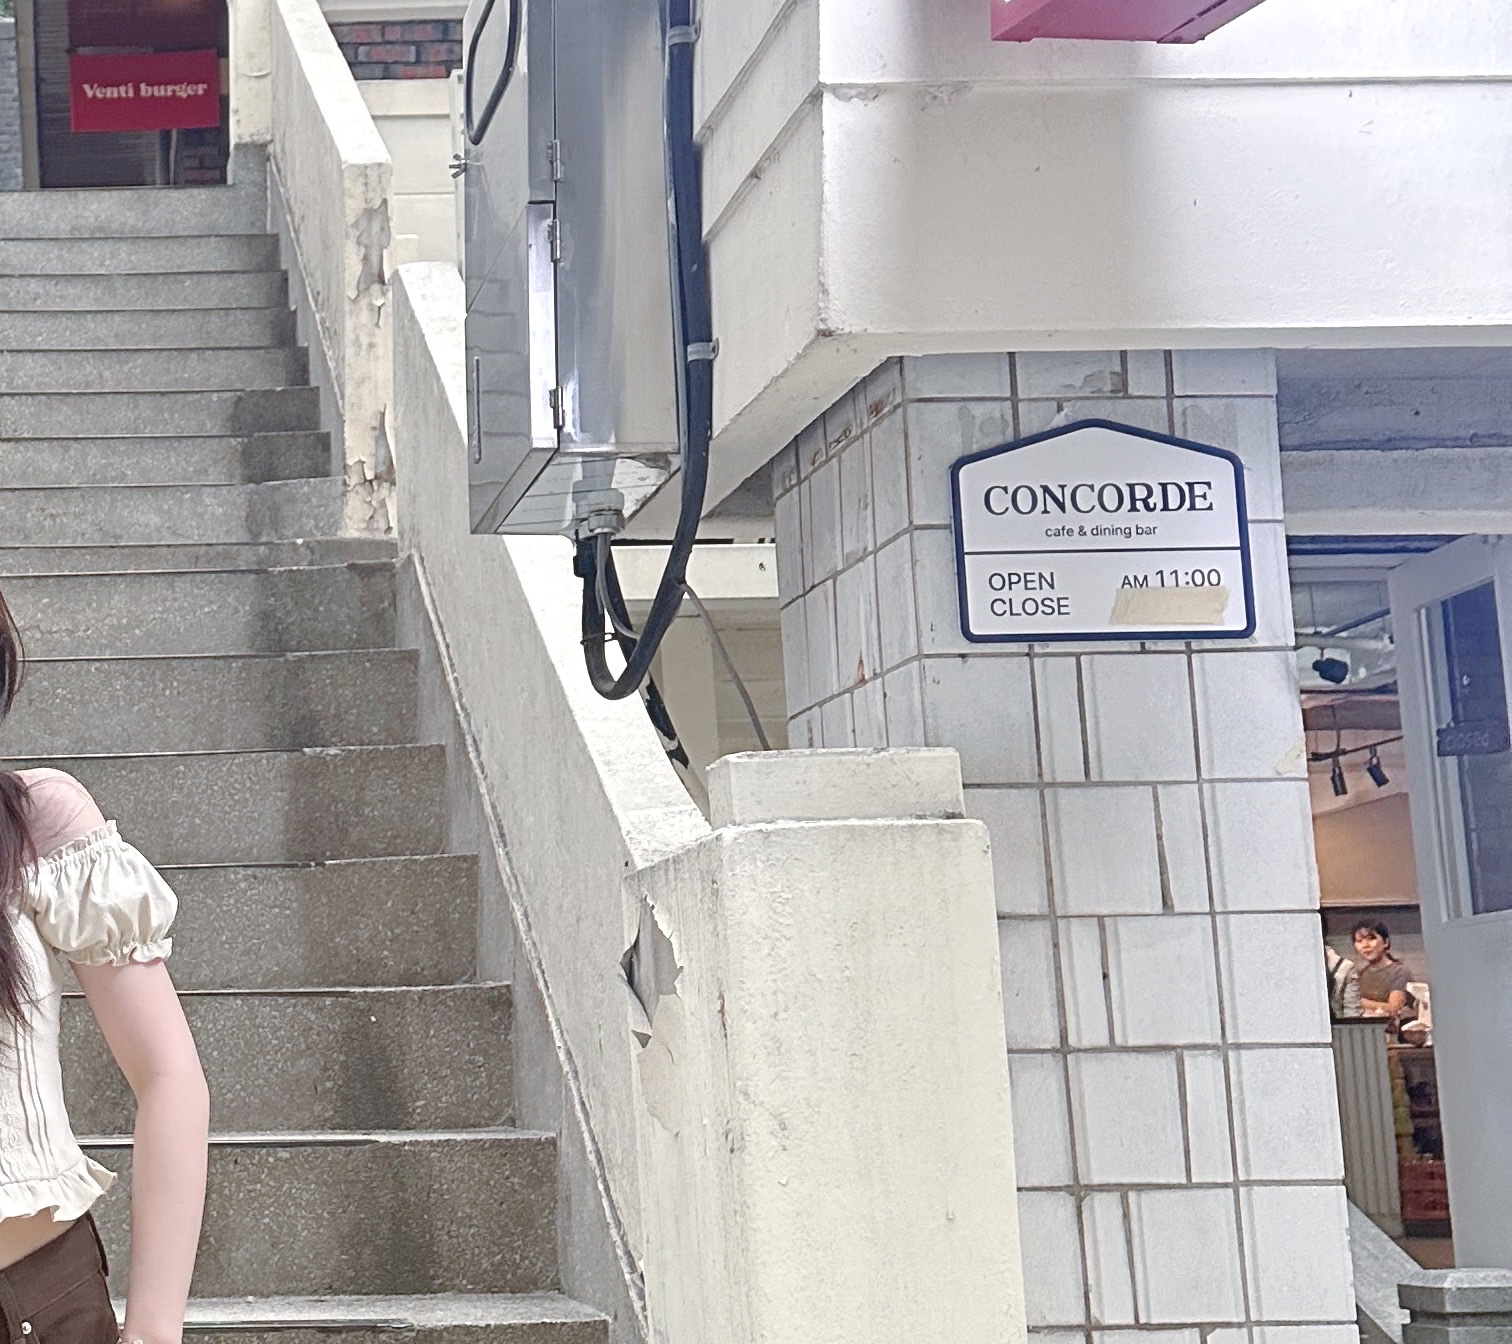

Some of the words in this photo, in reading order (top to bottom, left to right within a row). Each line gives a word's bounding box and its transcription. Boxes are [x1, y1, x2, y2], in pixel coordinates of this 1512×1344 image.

[82, 83, 135, 98] Venti
[139, 81, 208, 98] burger
[983, 481, 1214, 516] CONCORDE
[1045, 525, 1075, 537] cafe
[1077, 525, 1087, 536] &
[1090, 523, 1132, 538] dining
[1135, 523, 1158, 536] bar
[988, 571, 1055, 591] OPEN
[1120, 574, 1150, 589] AM
[1155, 568, 1222, 588] 11:00
[990, 596, 1071, 617] CLOSE
